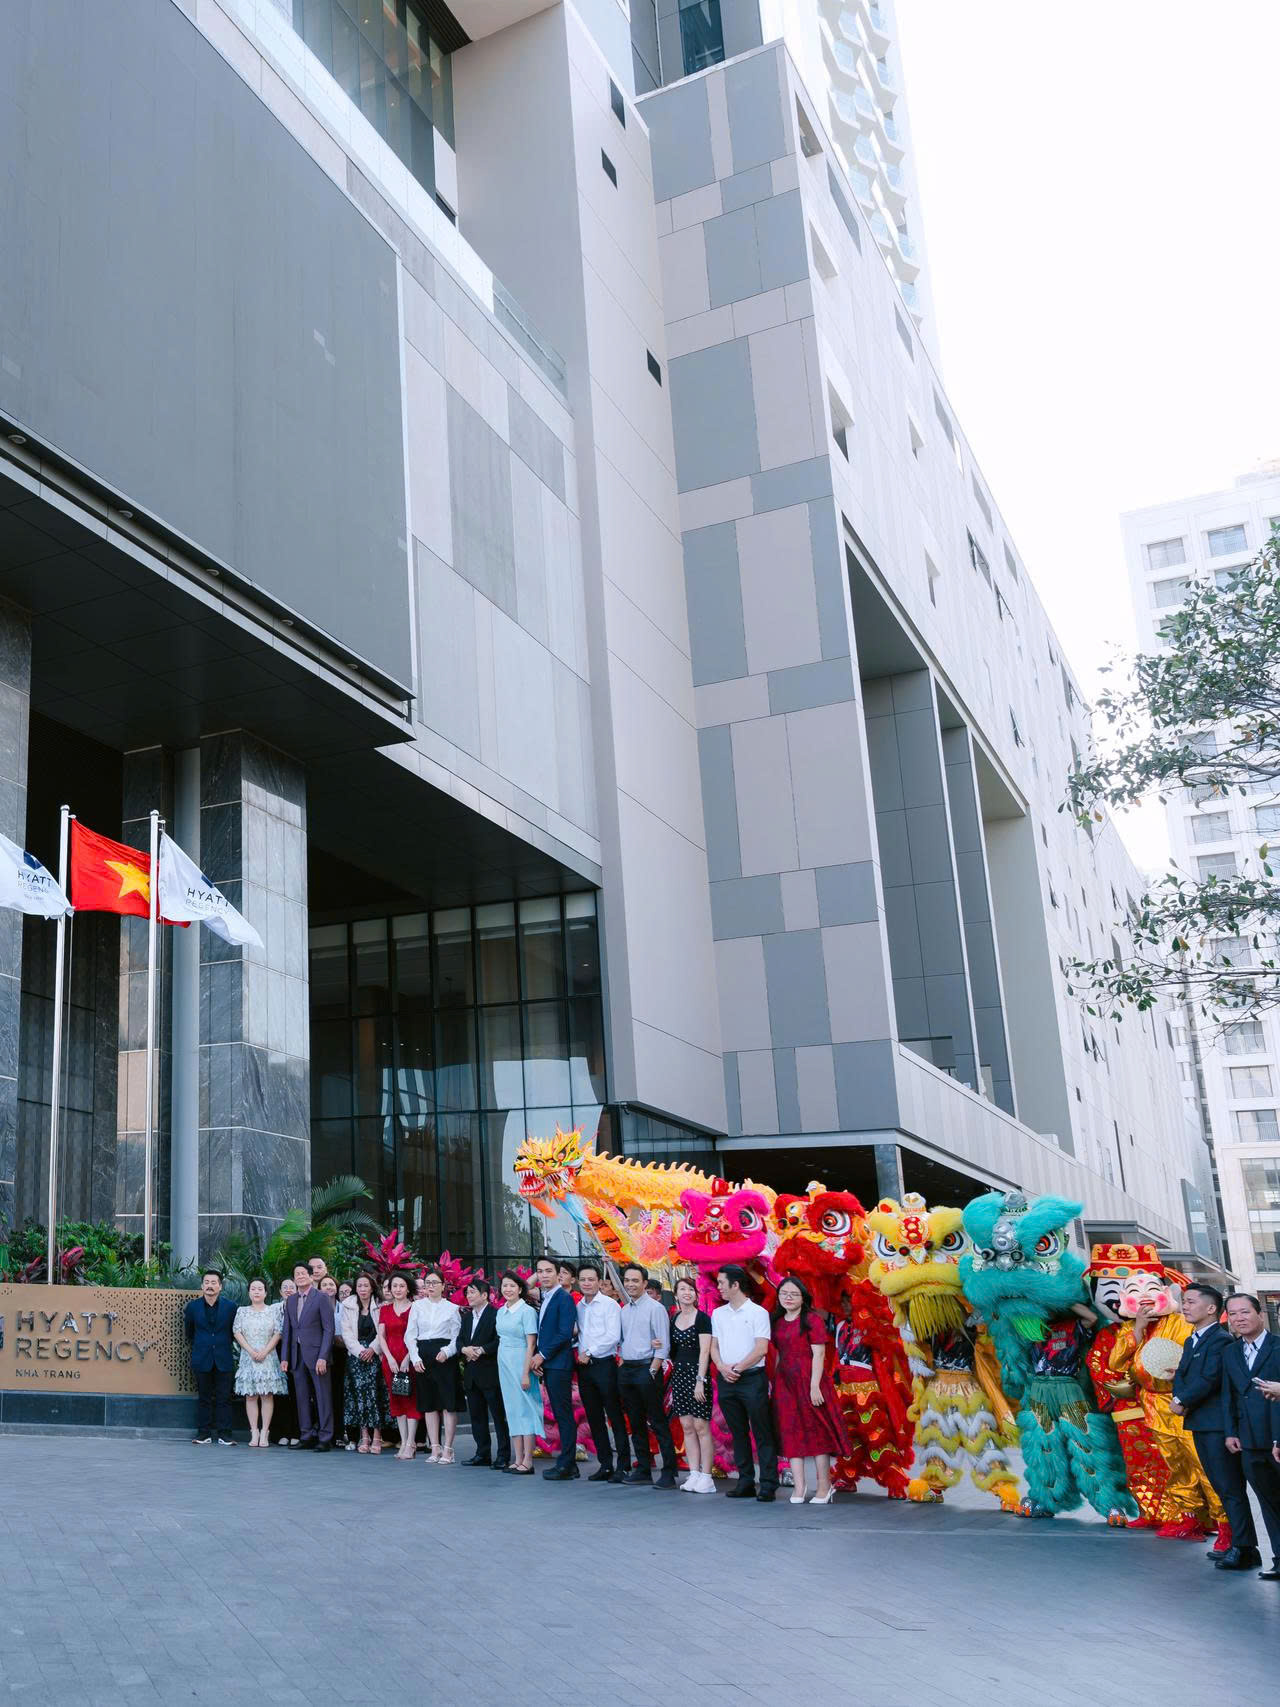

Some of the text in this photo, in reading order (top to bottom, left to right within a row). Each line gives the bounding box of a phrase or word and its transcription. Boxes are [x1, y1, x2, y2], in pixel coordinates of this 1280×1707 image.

[16, 1310, 118, 1334] HYATT
[16, 1337, 154, 1363] REGENCY
[16, 1368, 81, 1380] NHA TRANG
